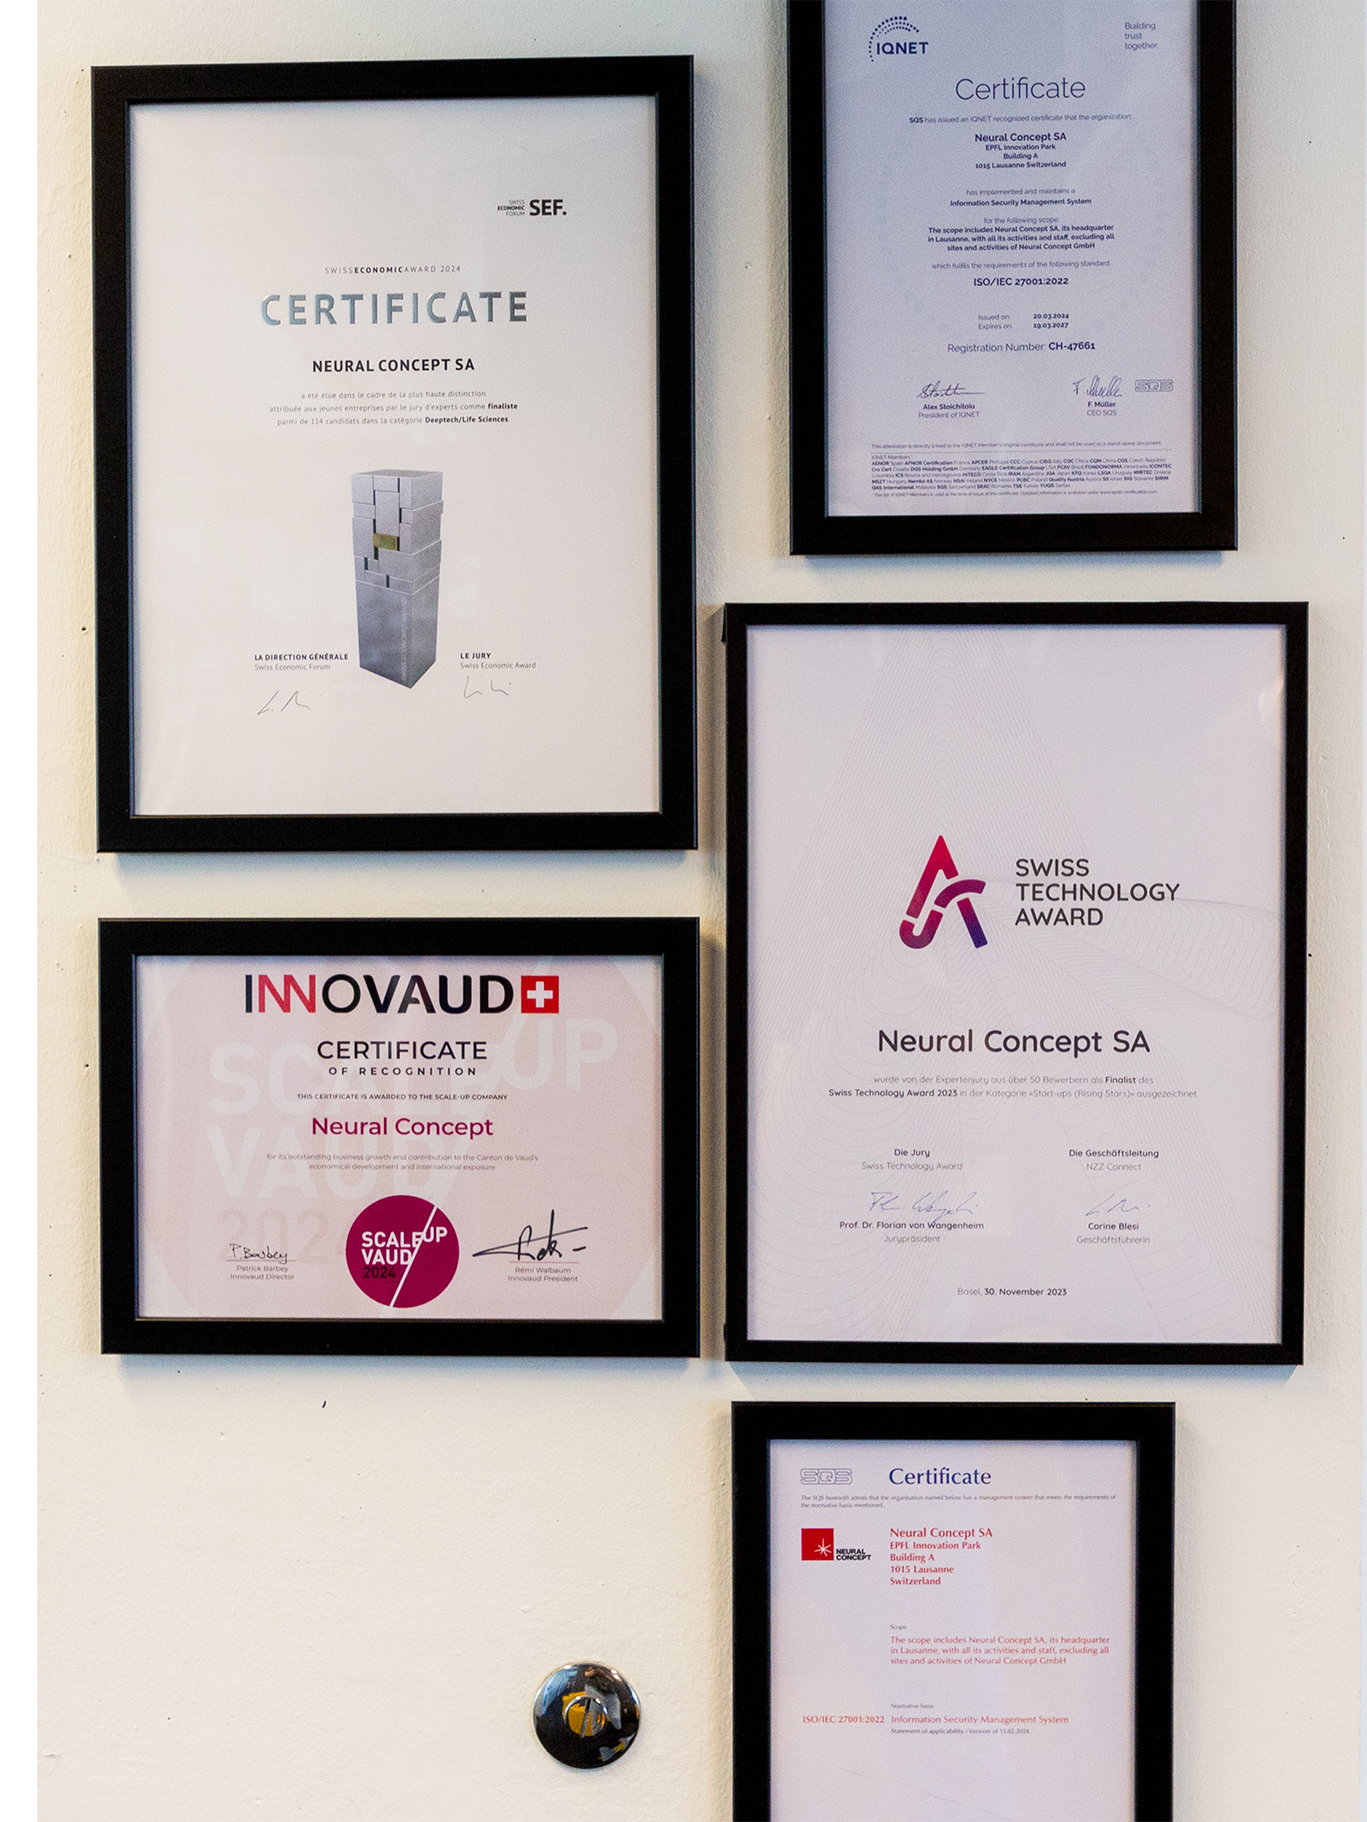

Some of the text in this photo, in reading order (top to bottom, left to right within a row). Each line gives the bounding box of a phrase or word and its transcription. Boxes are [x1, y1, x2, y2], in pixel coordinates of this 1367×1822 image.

[1124, 21, 1156, 31] Building
[1124, 32, 1142, 40] trust
[876, 41, 929, 55] IQNET
[955, 75, 1086, 100] Certificate
[975, 132, 1067, 142] Neural Concept SA
[985, 144, 1002, 152] EPFL
[1003, 152, 1032, 160] Building
[1026, 160, 1066, 168] Switzerland
[950, 198, 1092, 207] Information Security Management System
[973, 277, 1069, 287] ISO/IEC 27001:2022
[262, 290, 527, 326] CERTIFICATE
[1033, 322, 1069, 330] 19.03.2027
[947, 343, 1003, 354] Registration
[1048, 341, 1096, 351] CH-47661
[313, 358, 475, 373] NEURAL CONCEPT SA
[265, 653, 307, 661] DIRECTION
[308, 652, 348, 660] GÉNÉRALE
[254, 663, 273, 671] Swiss
[275, 663, 307, 671] Economic
[480, 661, 513, 669] Economic
[1016, 858, 1089, 877] SWISS
[1015, 883, 1180, 901] TECHNOLOGY
[1015, 907, 1103, 926] AWARD
[245, 973, 514, 1015] INNOVAUD
[879, 1028, 1150, 1059] Neural Concept SA
[317, 1040, 487, 1060] CERTIFICATE
[328, 1066, 476, 1076] OF RECOGNITION
[919, 1075, 933, 1083] der
[935, 1075, 989, 1085] Expertenjury
[1030, 1075, 1041, 1084] 50
[1042, 1076, 1089, 1084] Bewerbern
[1090, 1076, 1103, 1084] als
[1105, 1076, 1136, 1084] Finalist
[1138, 1076, 1154, 1084] des
[312, 1116, 494, 1140] Neural Concept
[894, 1148, 930, 1158] Die Jury
[1069, 1149, 1159, 1159] Die Geschäftsleitung
[861, 1161, 963, 1172] Swiss Technology Award
[1086, 1162, 1142, 1171] NZZ Connect
[876, 1221, 907, 1229] Florian
[927, 1221, 984, 1231] Wangenheim
[1087, 1222, 1139, 1230] Corine Blesi
[884, 1235, 941, 1244] Jurypräsident
[1076, 1235, 1150, 1244] Geschäftsführerin
[361, 1248, 413, 1265] VAUD
[263, 1263, 289, 1273] Barbey
[362, 1266, 396, 1279] 2024
[999, 1288, 1044, 1296] November
[1047, 1288, 1067, 1296] 2023
[889, 1467, 991, 1485] Certificate
[890, 1527, 993, 1540] Neural Concept SA
[890, 1541, 981, 1549] EPFL Innovation Park
[890, 1553, 935, 1563] Building A
[890, 1565, 954, 1573] 1015 Lausanne
[890, 1576, 941, 1585] Switzerland
[802, 1715, 884, 1723] ISO/IEC 27001:2022
[891, 1715, 1069, 1726] Information Security Management System
